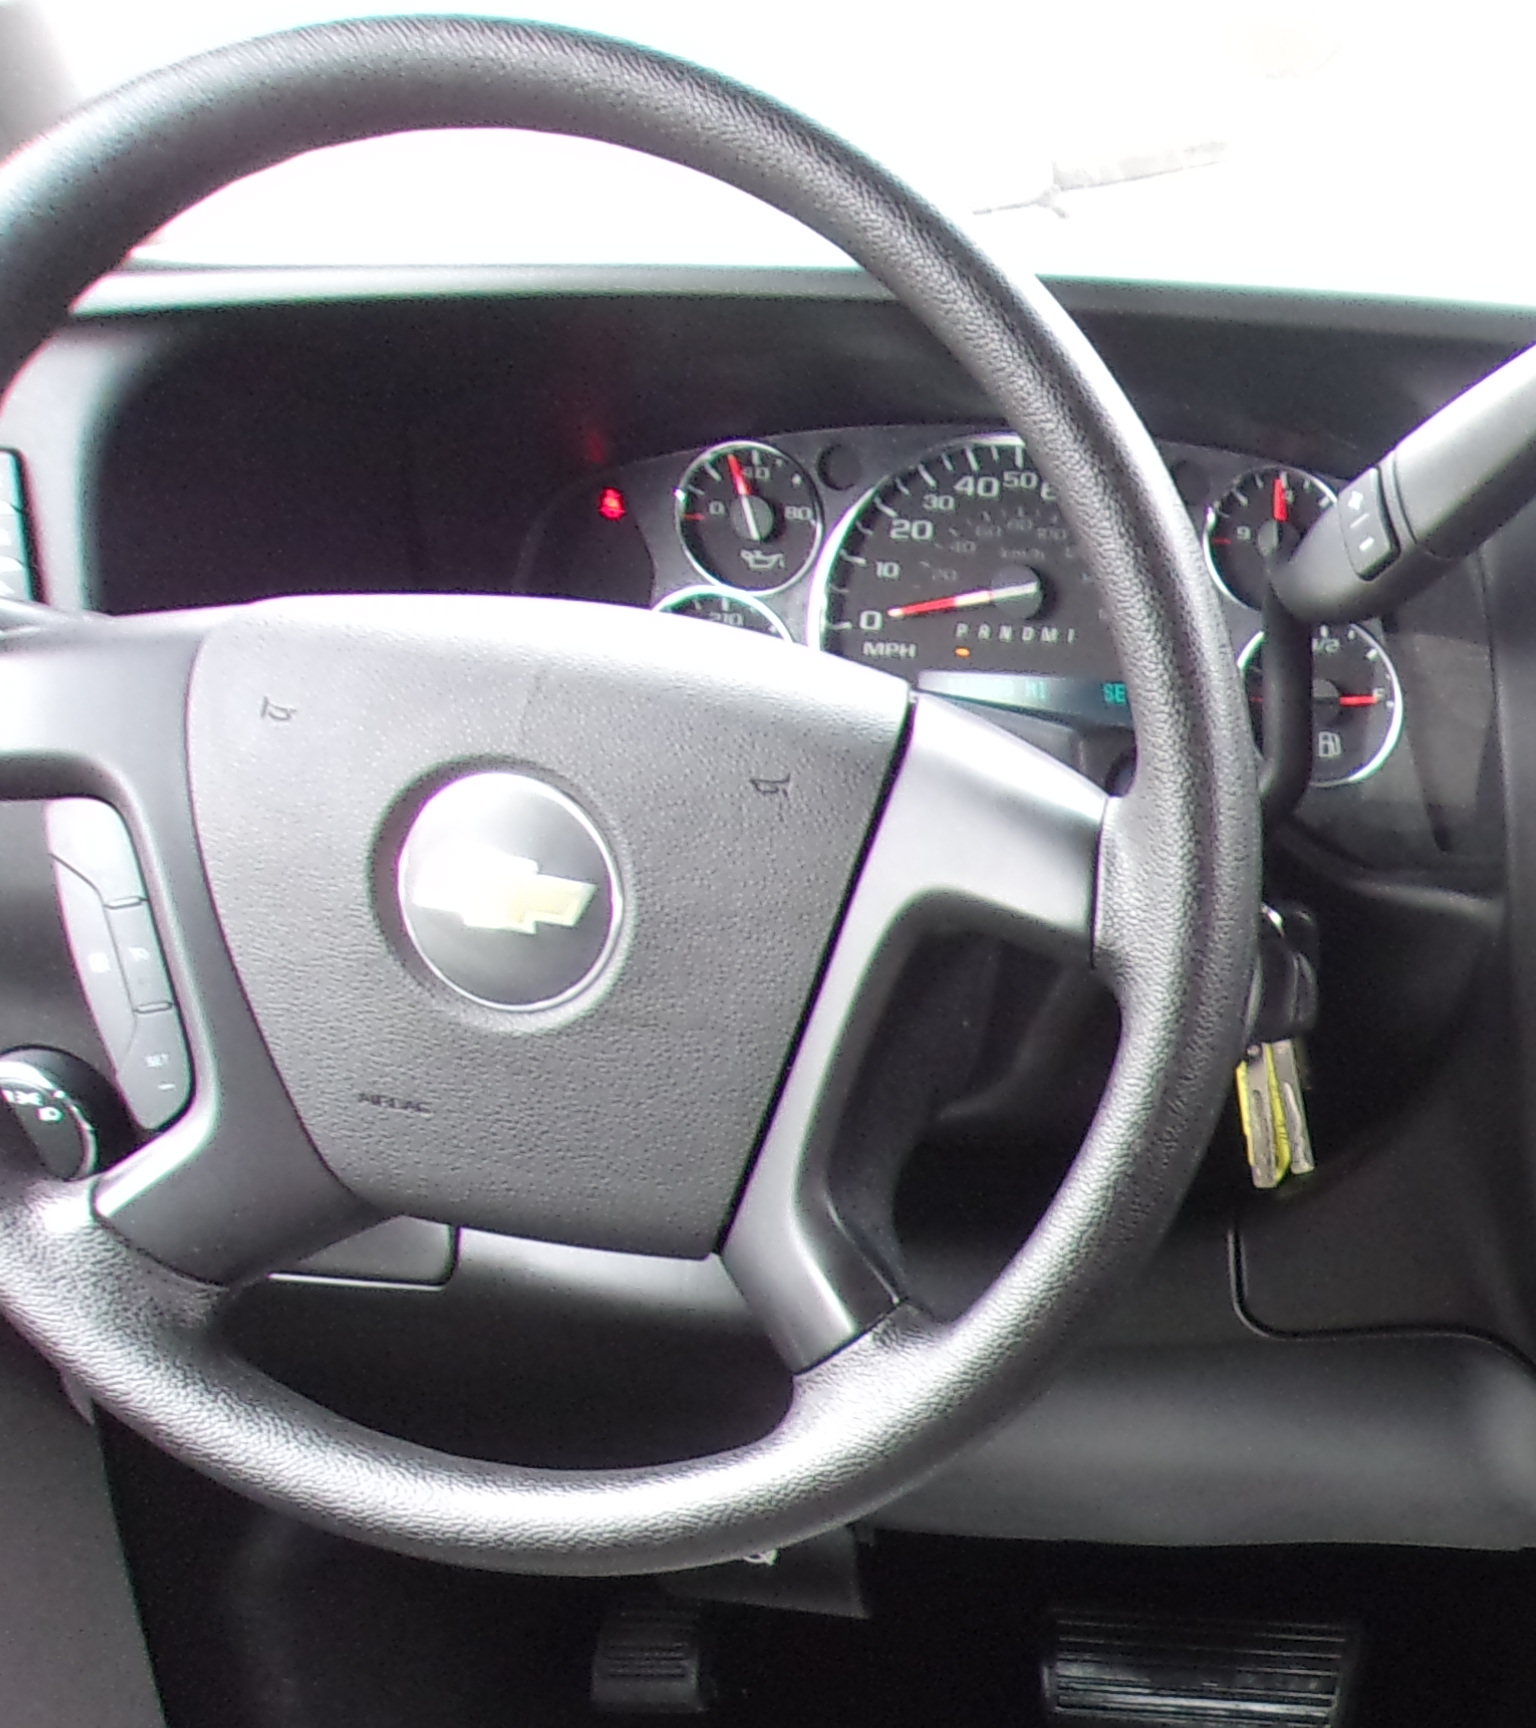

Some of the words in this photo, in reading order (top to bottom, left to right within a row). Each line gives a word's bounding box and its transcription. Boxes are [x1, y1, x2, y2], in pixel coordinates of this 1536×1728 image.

[953, 476, 1000, 498] 40
[1002, 472, 1039, 489] 50
[708, 500, 725, 515] 0
[923, 494, 955, 512] 30
[785, 506, 813, 521] 80
[890, 519, 934, 541] 20
[875, 562, 900, 579] 10
[859, 611, 882, 631] 0
[956, 623, 969, 637] P
[978, 624, 991, 638] R
[1000, 625, 1012, 640] N
[1022, 626, 1035, 641] D
[863, 641, 917, 660] MPH
